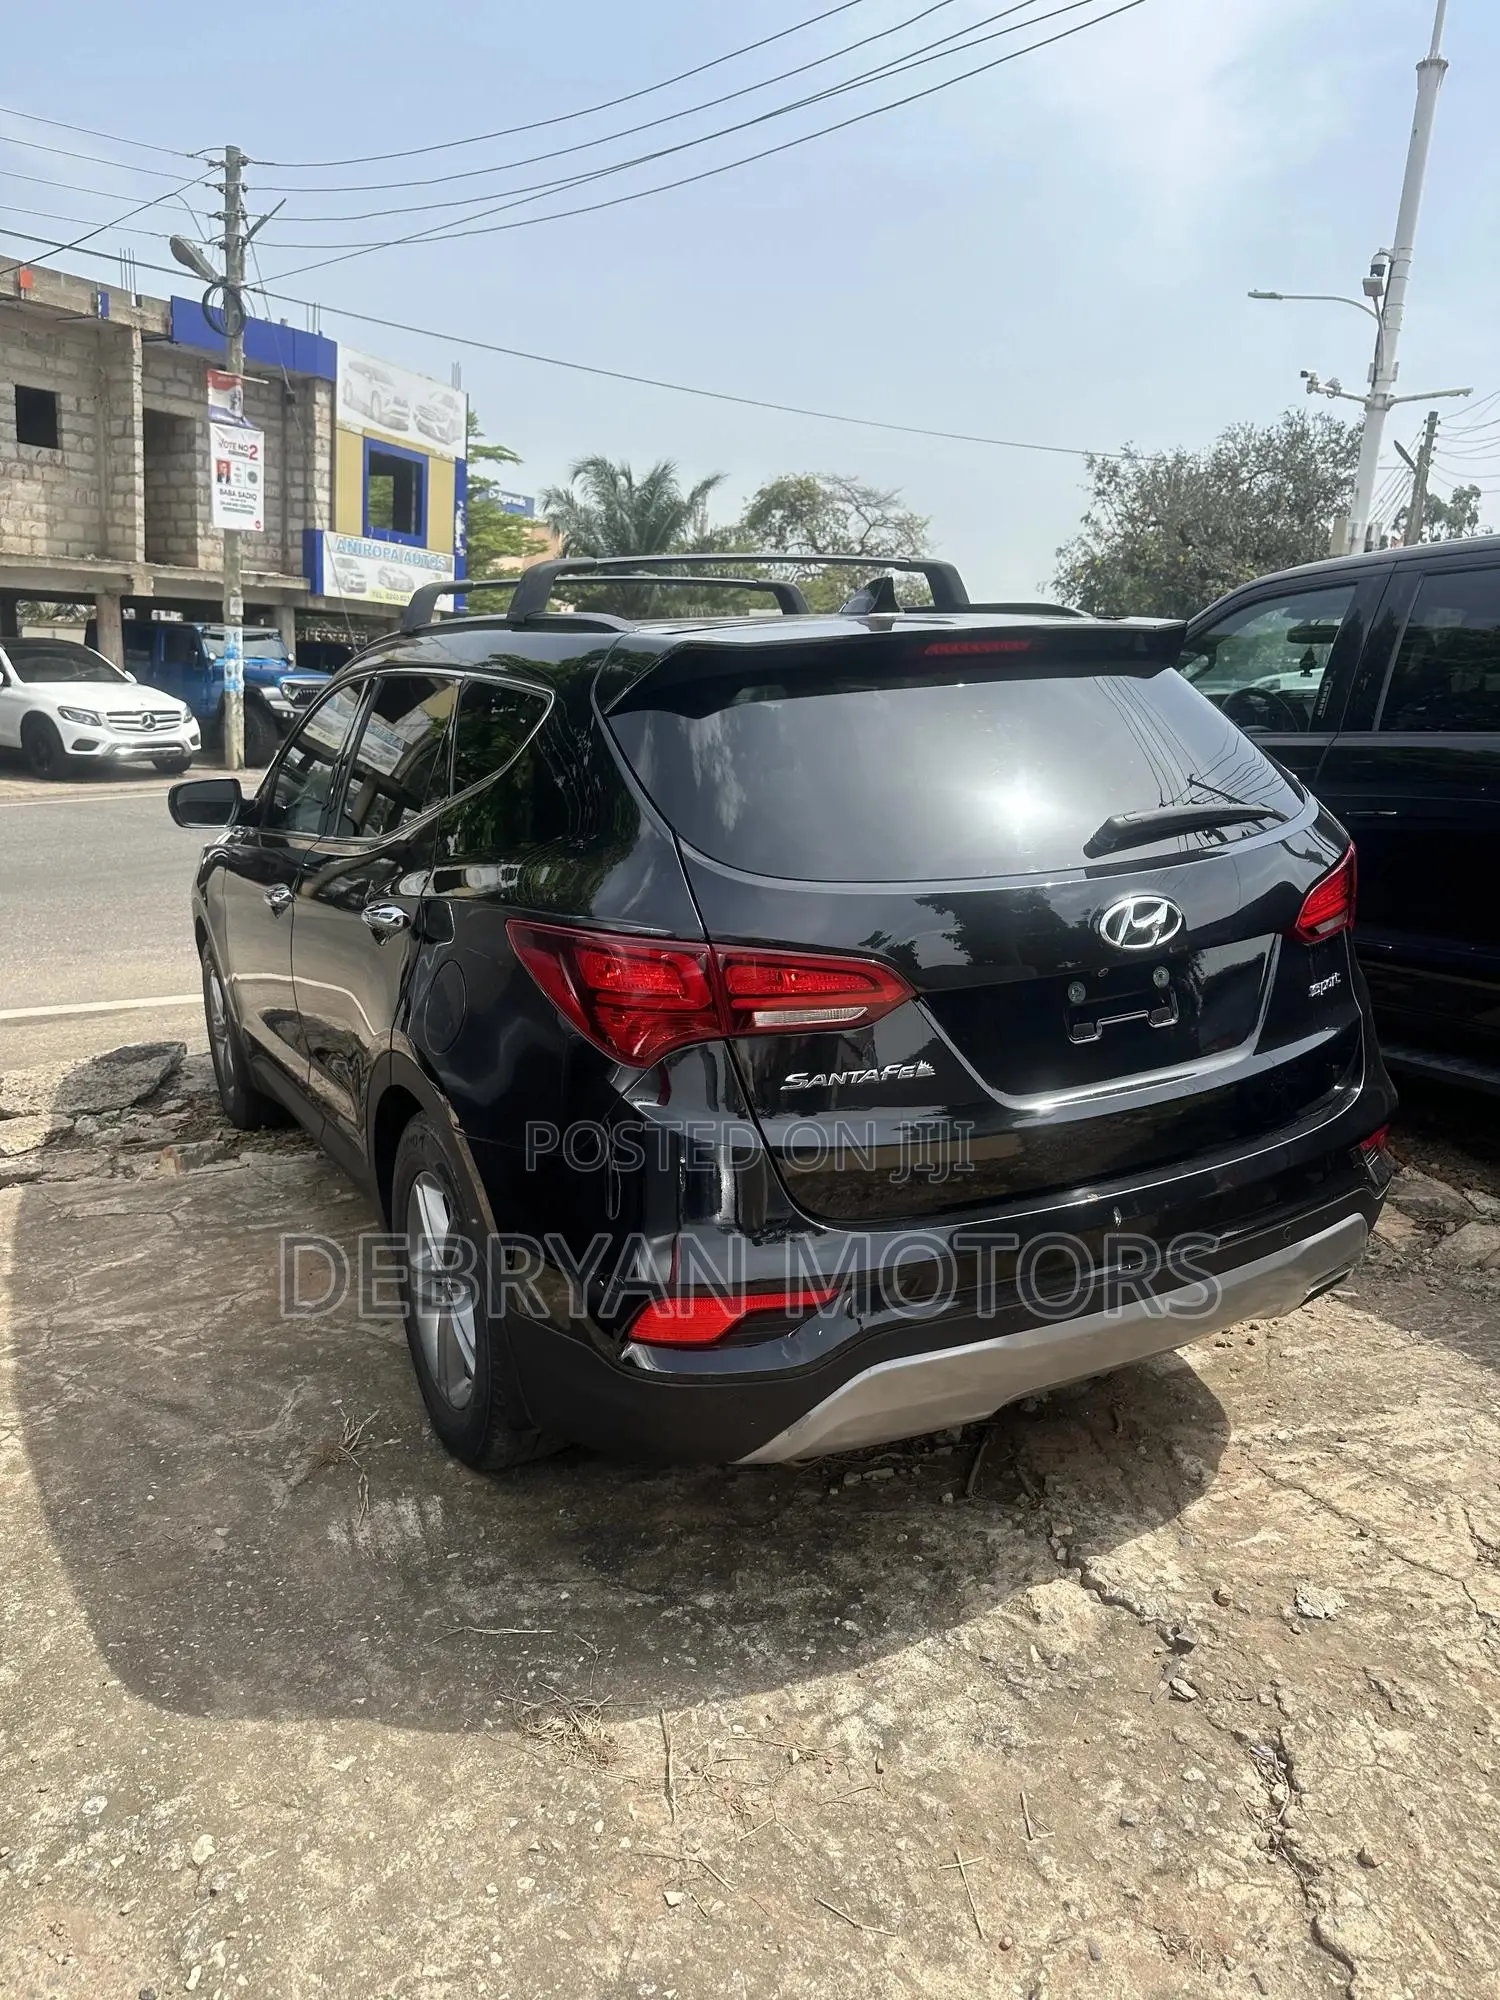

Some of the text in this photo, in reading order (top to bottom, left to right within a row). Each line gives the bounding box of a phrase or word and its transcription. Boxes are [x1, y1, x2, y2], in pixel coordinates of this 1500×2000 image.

[219, 438, 237, 451] VOTE
[249, 444, 259, 461] 2
[336, 538, 447, 571] ANIROPA AUTOS
